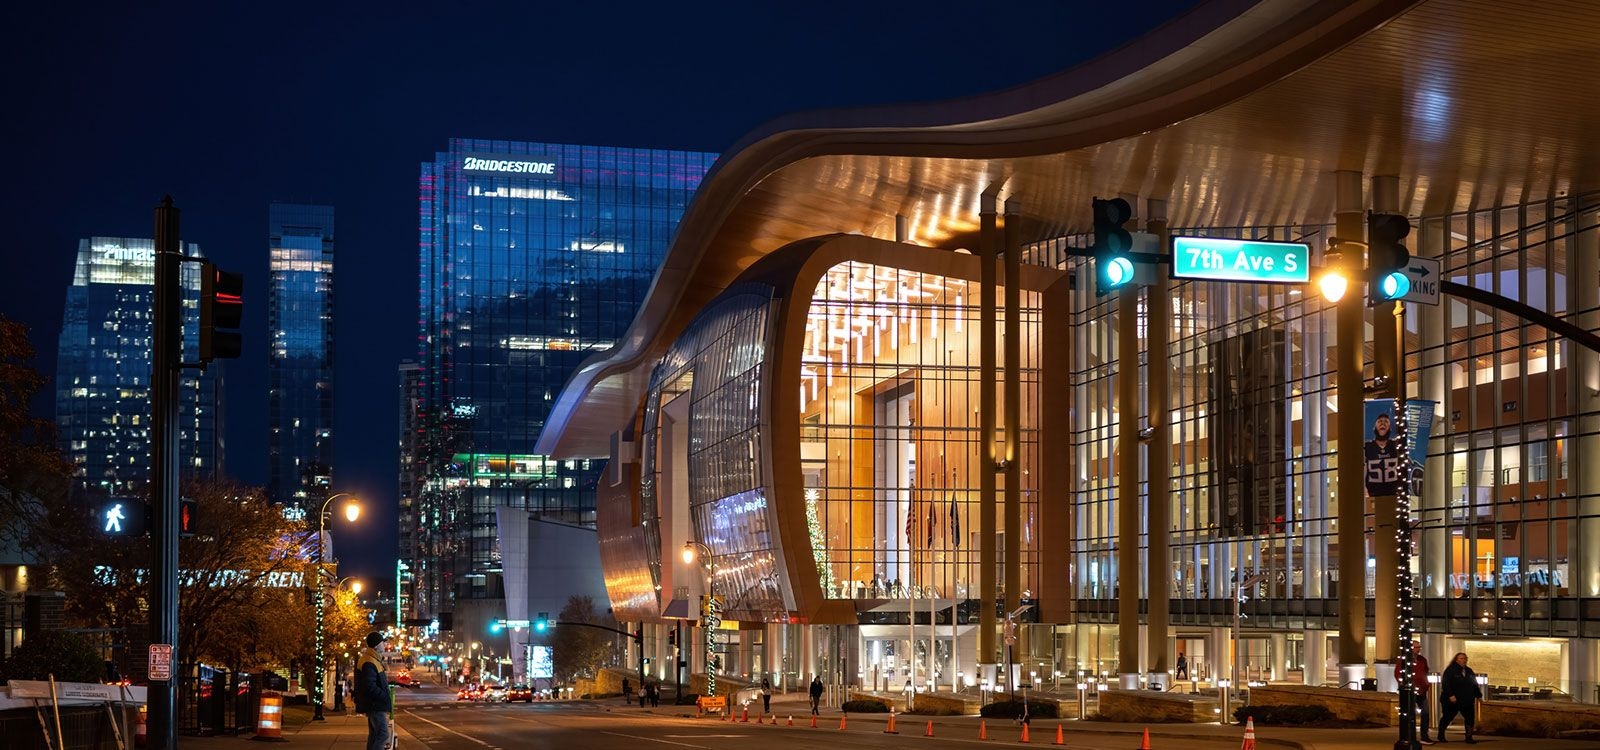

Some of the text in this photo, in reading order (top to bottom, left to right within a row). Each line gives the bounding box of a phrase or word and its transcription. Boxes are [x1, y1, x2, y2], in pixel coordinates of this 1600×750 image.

[463, 157, 555, 174] BRIDGESTONE
[104, 244, 155, 261] Pinnac
[1186, 248, 1298, 272] 7th Ave S
[1410, 279, 1436, 295] KING
[1408, 405, 1421, 439] LANDRY
[1368, 458, 1398, 483] 58
[253, 571, 305, 588] AREN
